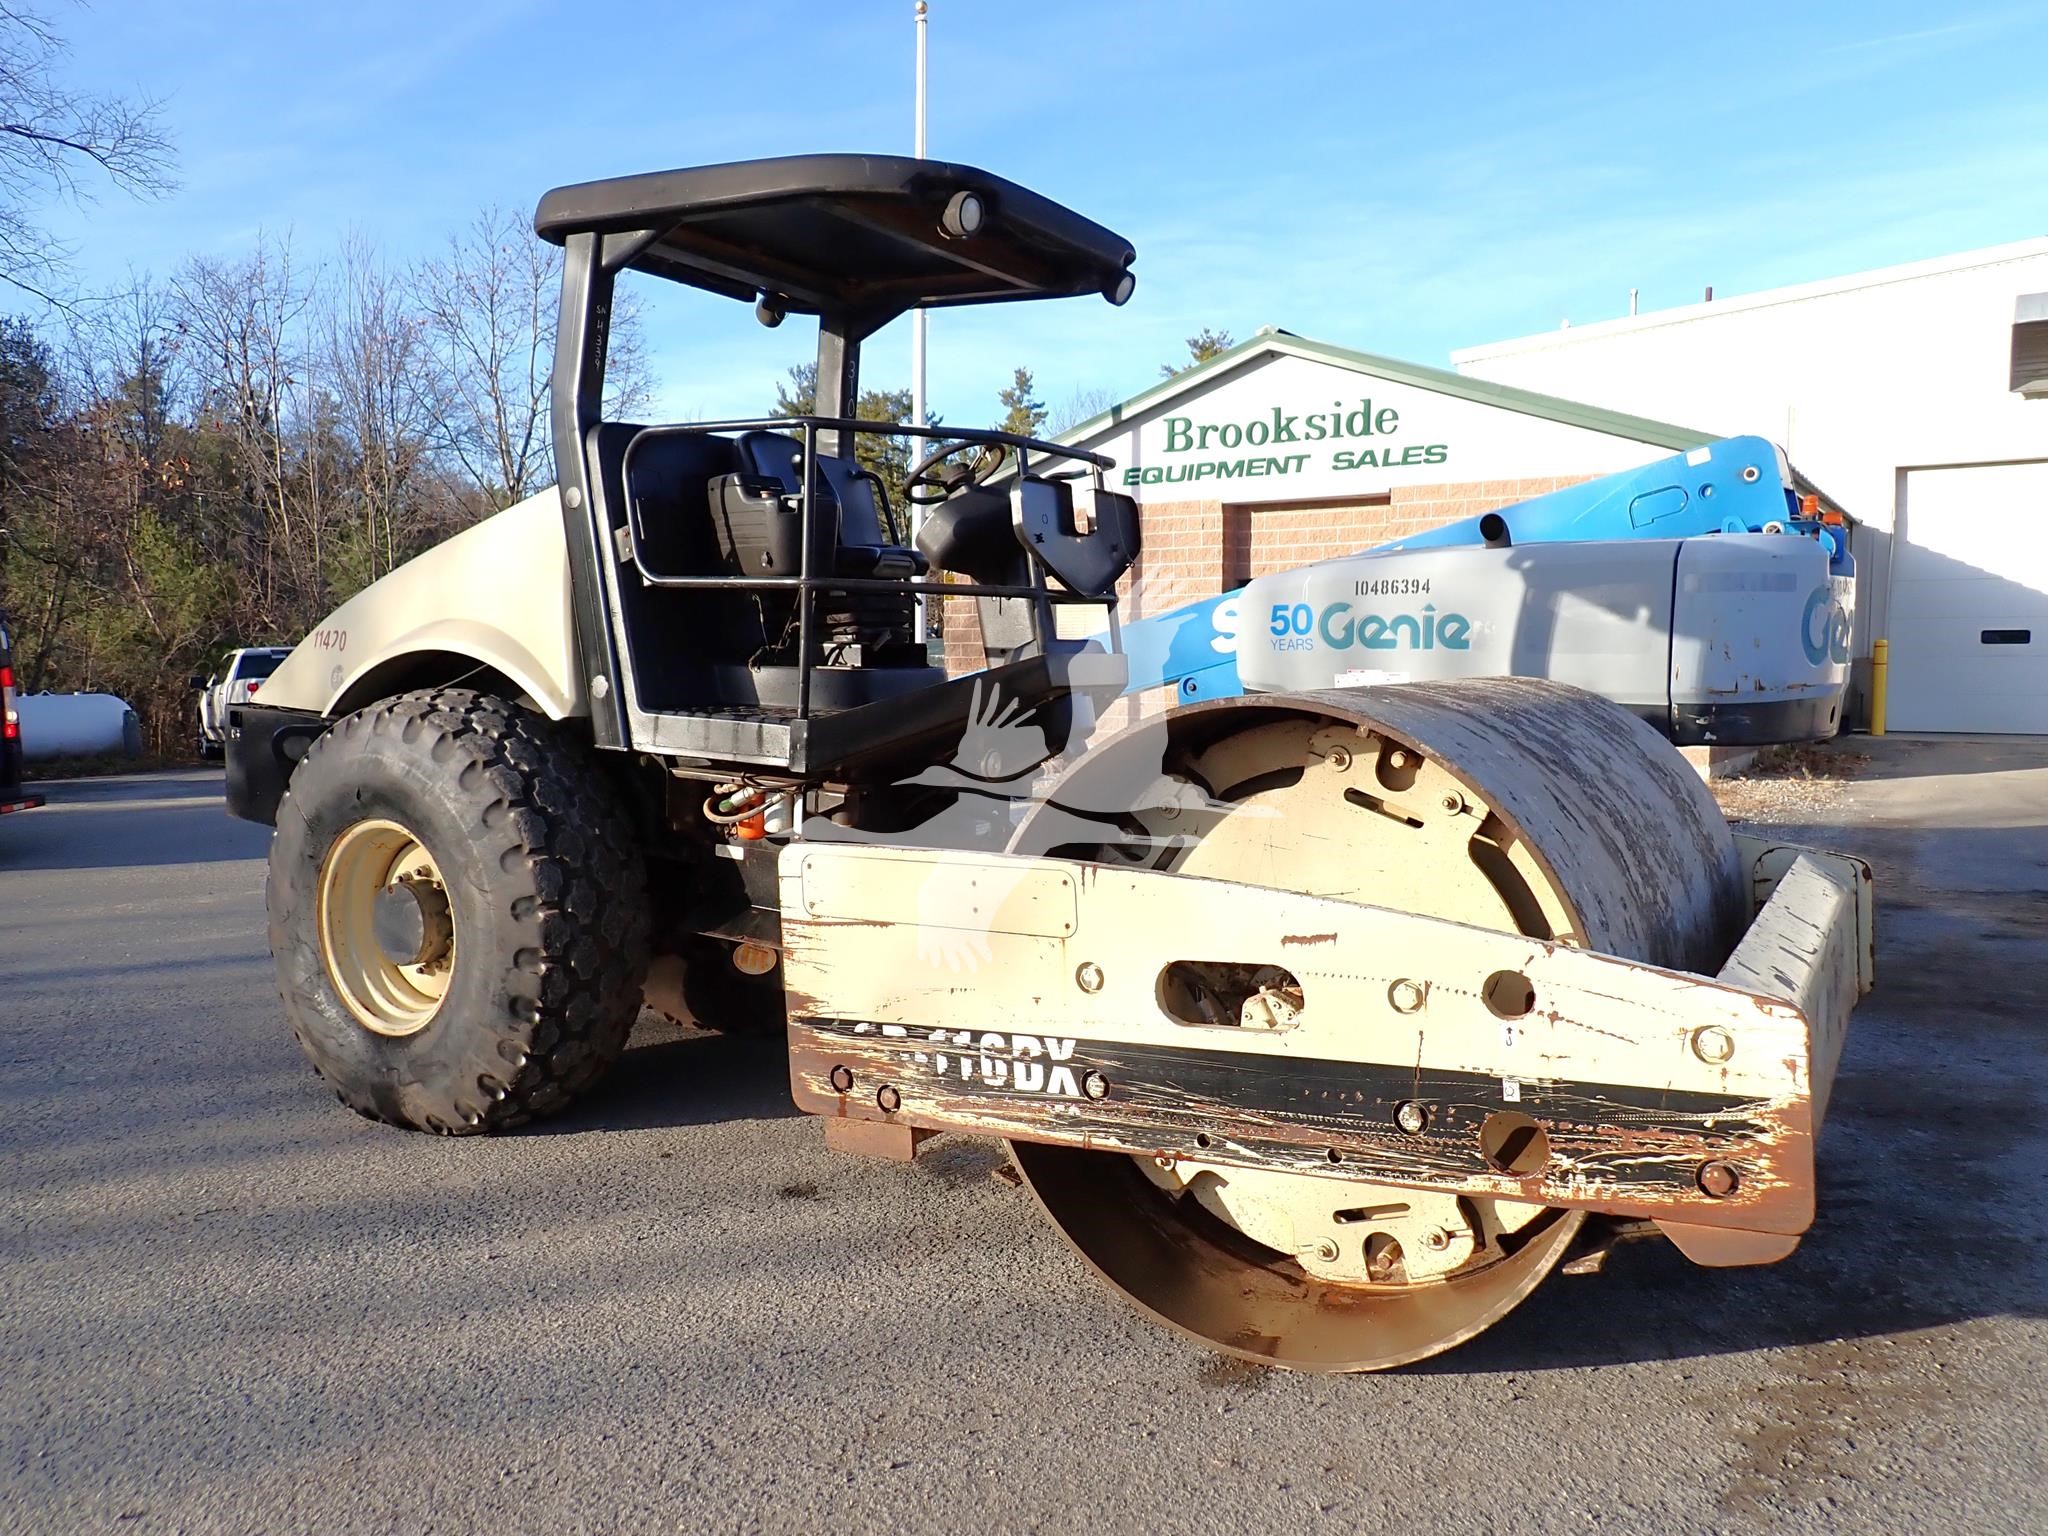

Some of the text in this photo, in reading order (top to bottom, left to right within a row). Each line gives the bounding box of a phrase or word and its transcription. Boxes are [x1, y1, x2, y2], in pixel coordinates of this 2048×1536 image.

[1163, 398, 1399, 452] Brookside
[1123, 444, 1448, 486] EQUIPMENT SALES
[1355, 578, 1431, 596] 10486394
[1270, 603, 1313, 637] 50
[1318, 601, 1471, 650] Genie
[1271, 638, 1313, 651] YEARS
